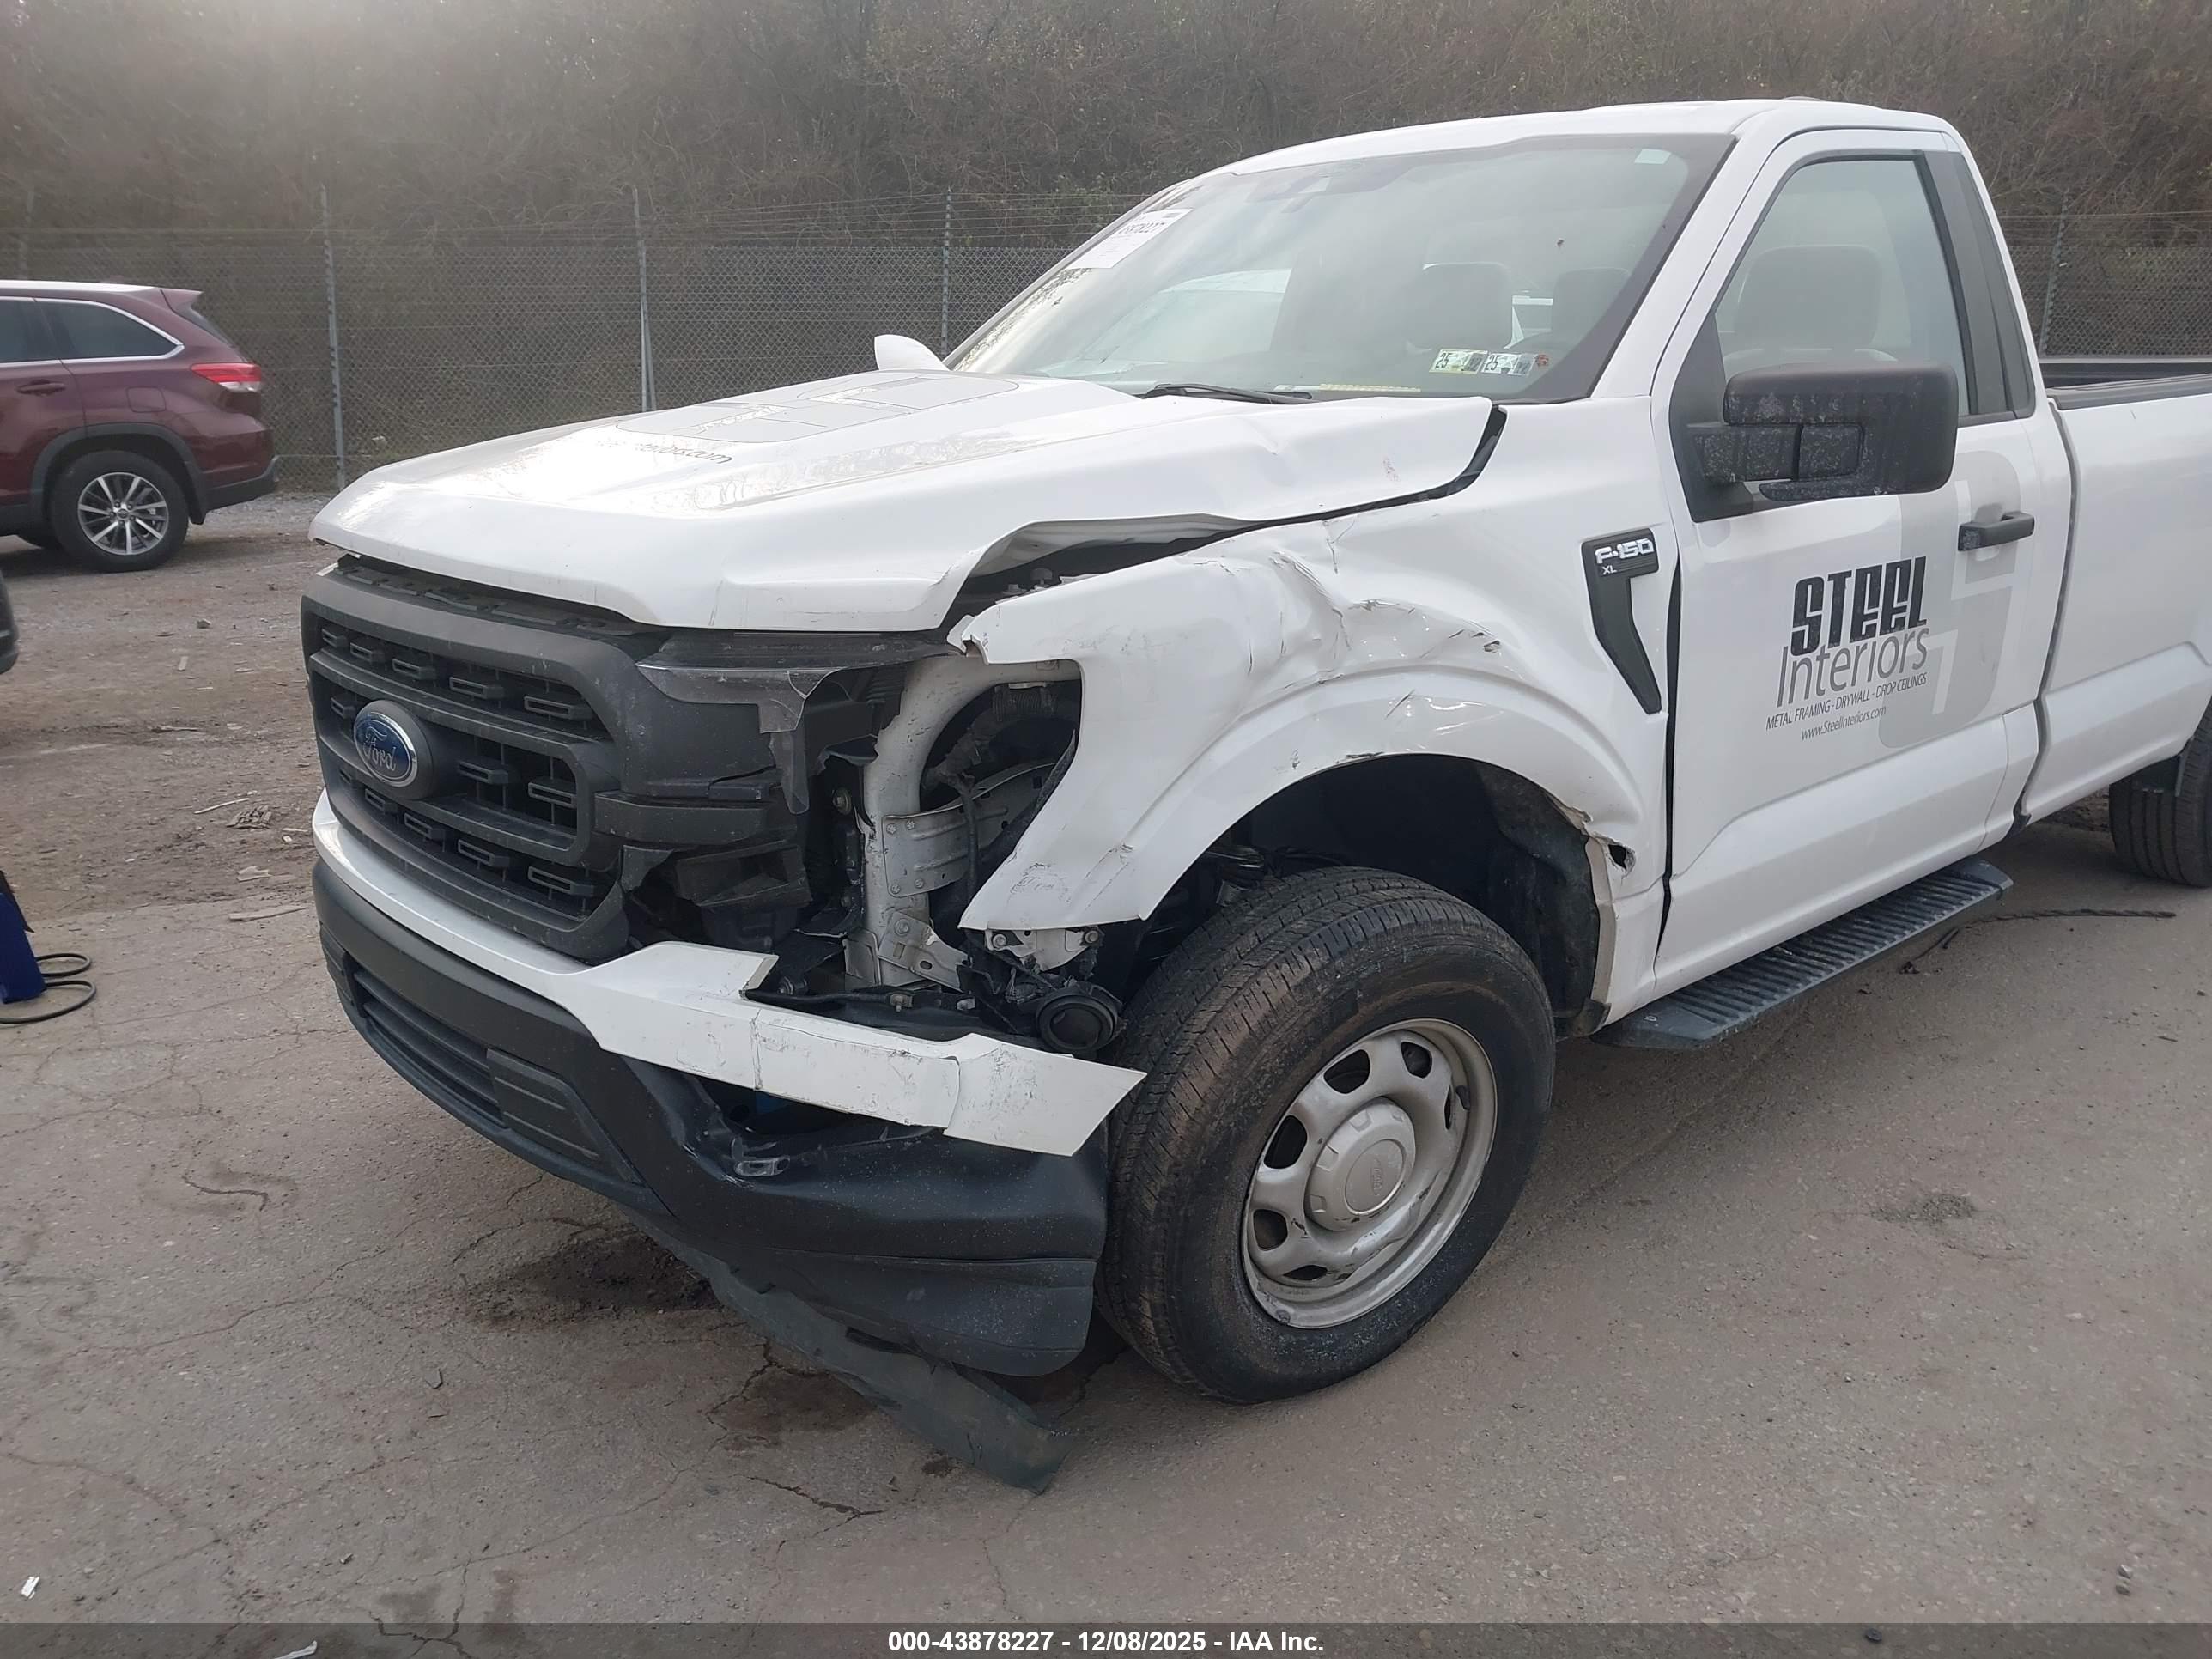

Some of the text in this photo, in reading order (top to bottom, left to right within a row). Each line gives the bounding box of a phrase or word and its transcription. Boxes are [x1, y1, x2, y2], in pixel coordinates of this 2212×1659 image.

[1435, 352, 1452, 368] 25
[1485, 355, 1501, 370] 25
[1595, 538, 1655, 564] F-150
[1602, 565, 1617, 575] XL
[1790, 556, 1927, 656] STEEL
[1777, 628, 1929, 708] Interiors
[1765, 712, 1792, 731] METAL
[1795, 699, 1831, 722] FRAMING
[1835, 689, 1870, 710] DRYWALL
[1876, 679, 1896, 698] DROP
[1897, 672, 1927, 694] CEILINGS
[1801, 706, 1887, 741] www.SteelInteriors.com
[362, 726, 397, 772] Ford
